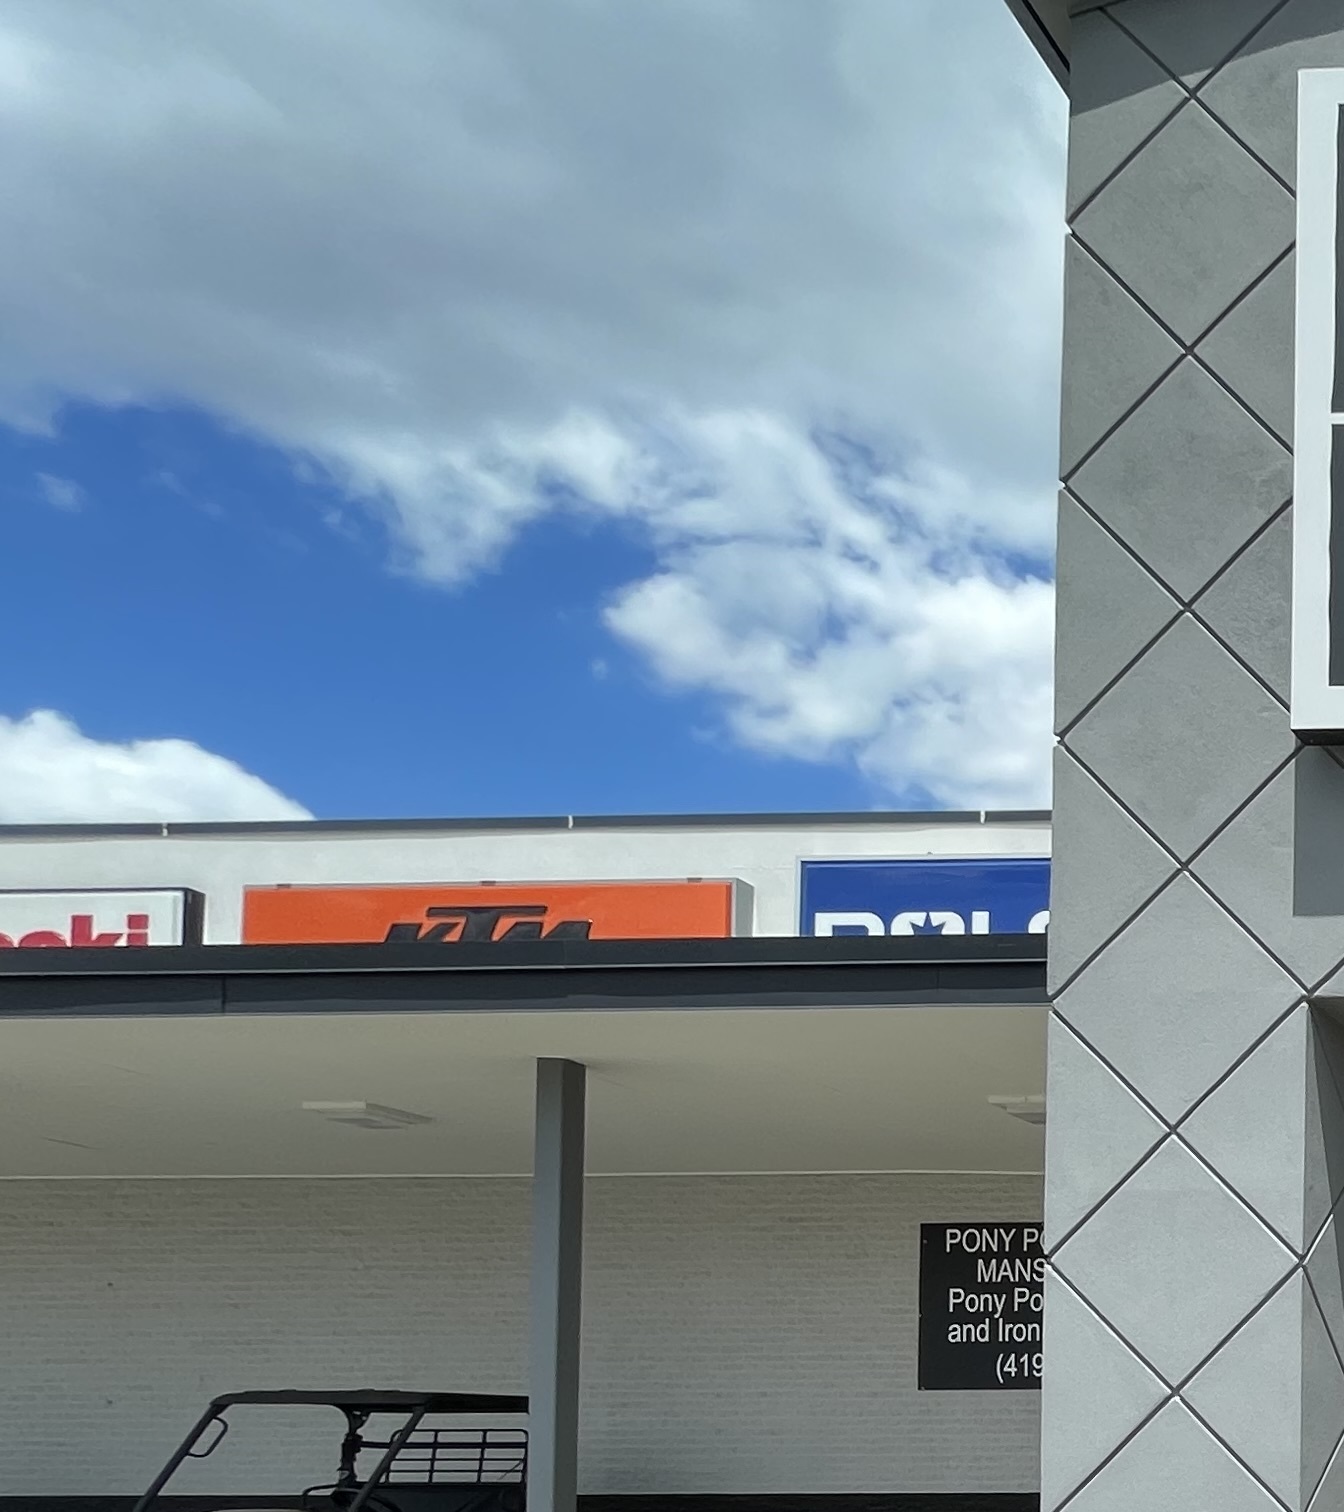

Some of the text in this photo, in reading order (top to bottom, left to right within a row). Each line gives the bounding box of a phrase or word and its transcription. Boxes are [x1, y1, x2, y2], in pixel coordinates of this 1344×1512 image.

[945, 1228, 1017, 1253] PONY
[948, 1287, 1043, 1319] Pony Po
[947, 1317, 1041, 1343] and Iron
